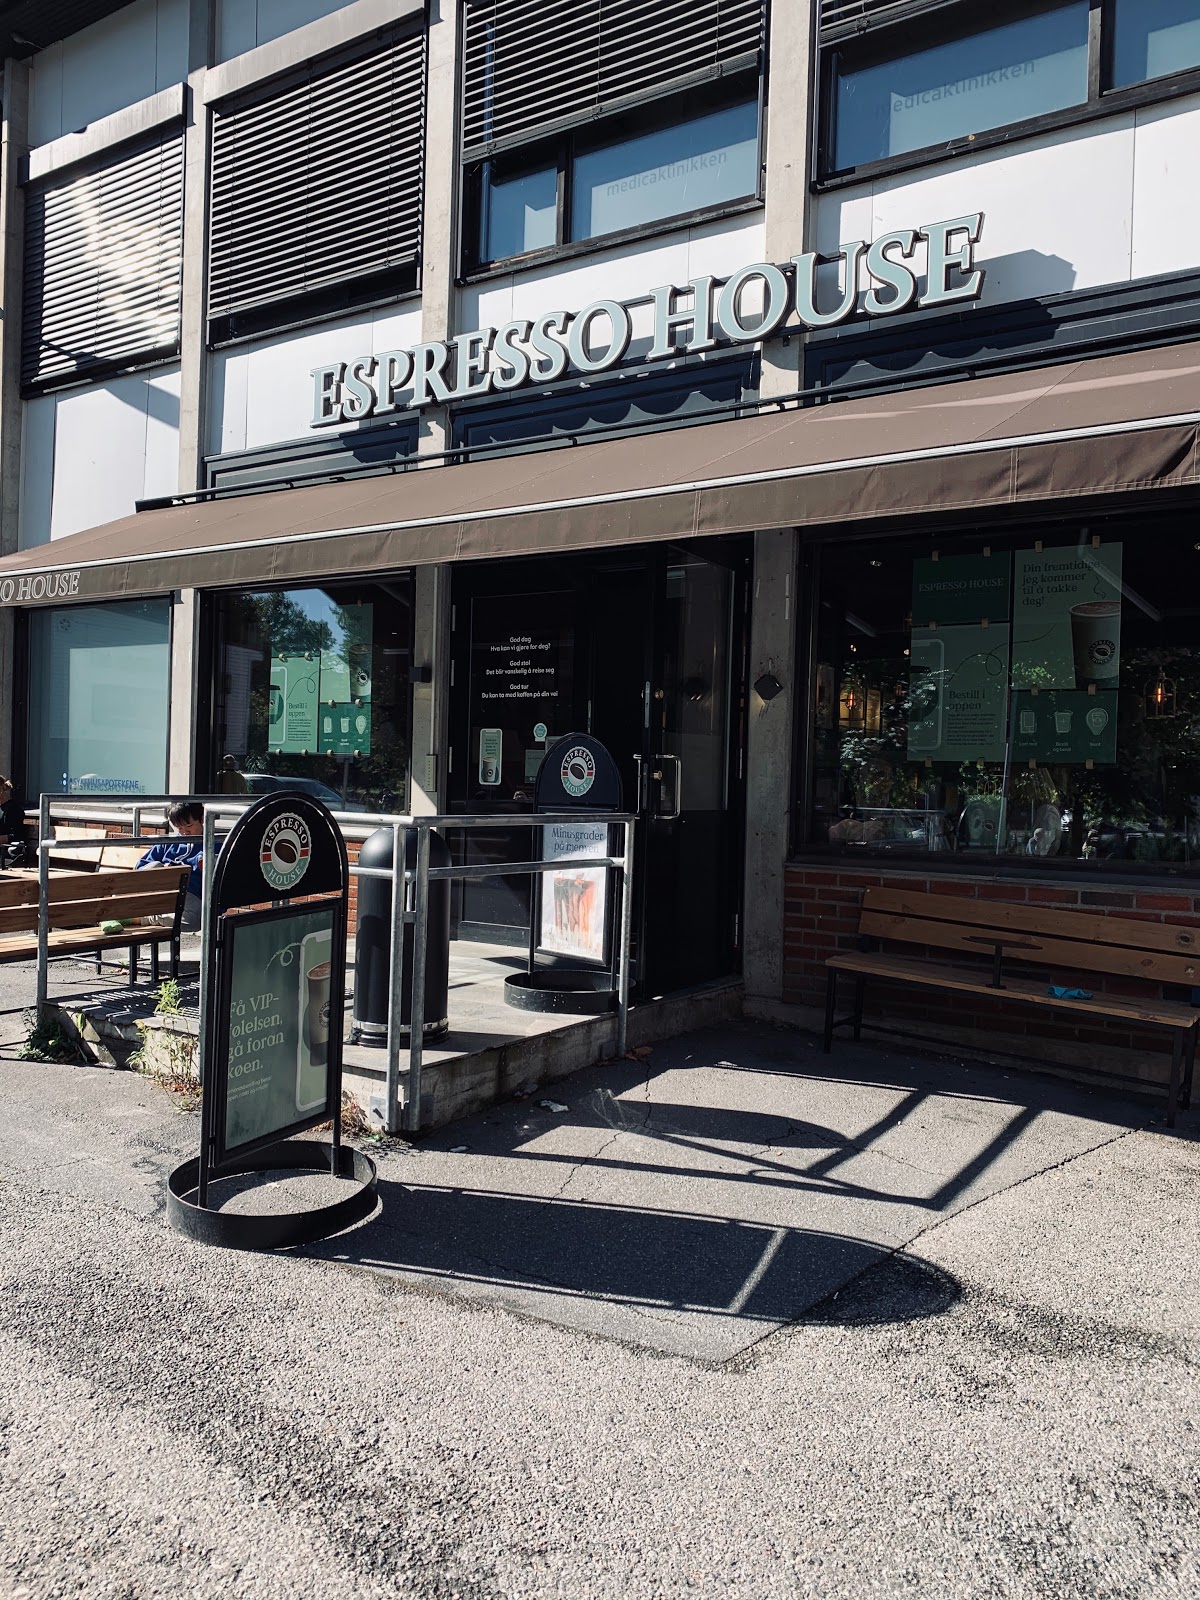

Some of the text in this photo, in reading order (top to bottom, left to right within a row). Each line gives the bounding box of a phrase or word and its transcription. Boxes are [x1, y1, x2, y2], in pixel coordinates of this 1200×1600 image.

[876, 60, 1035, 117] edicaklinikken
[606, 152, 727, 197] medicaklinikken
[309, 212, 985, 428] ESPRESSO HOUSE
[1023, 563, 1041, 573] Din
[16, 571, 80, 601] HOUSE
[918, 577, 1004, 592] ESPRESSO HOUSE
[1022, 573, 1087, 586] jeg kommer
[1022, 585, 1034, 594] til
[1047, 583, 1078, 593] takke
[1022, 596, 1045, 607] deg!
[520, 636, 532, 644] dag
[538, 642, 551, 651] deg?
[504, 668, 527, 676] vanskelig
[533, 690, 541, 698] på
[949, 690, 979, 699] Bestill
[564, 749, 593, 768] ESPRESSO
[565, 781, 589, 793] HOUSE
[264, 817, 308, 848] ESPRESSO
[551, 827, 604, 842] Minusgrader
[553, 841, 565, 853] på
[268, 865, 302, 885] HOUSE
[249, 992, 280, 1012] VIP-
[230, 1013, 283, 1039] ølelsen,
[246, 1032, 285, 1054] foran
